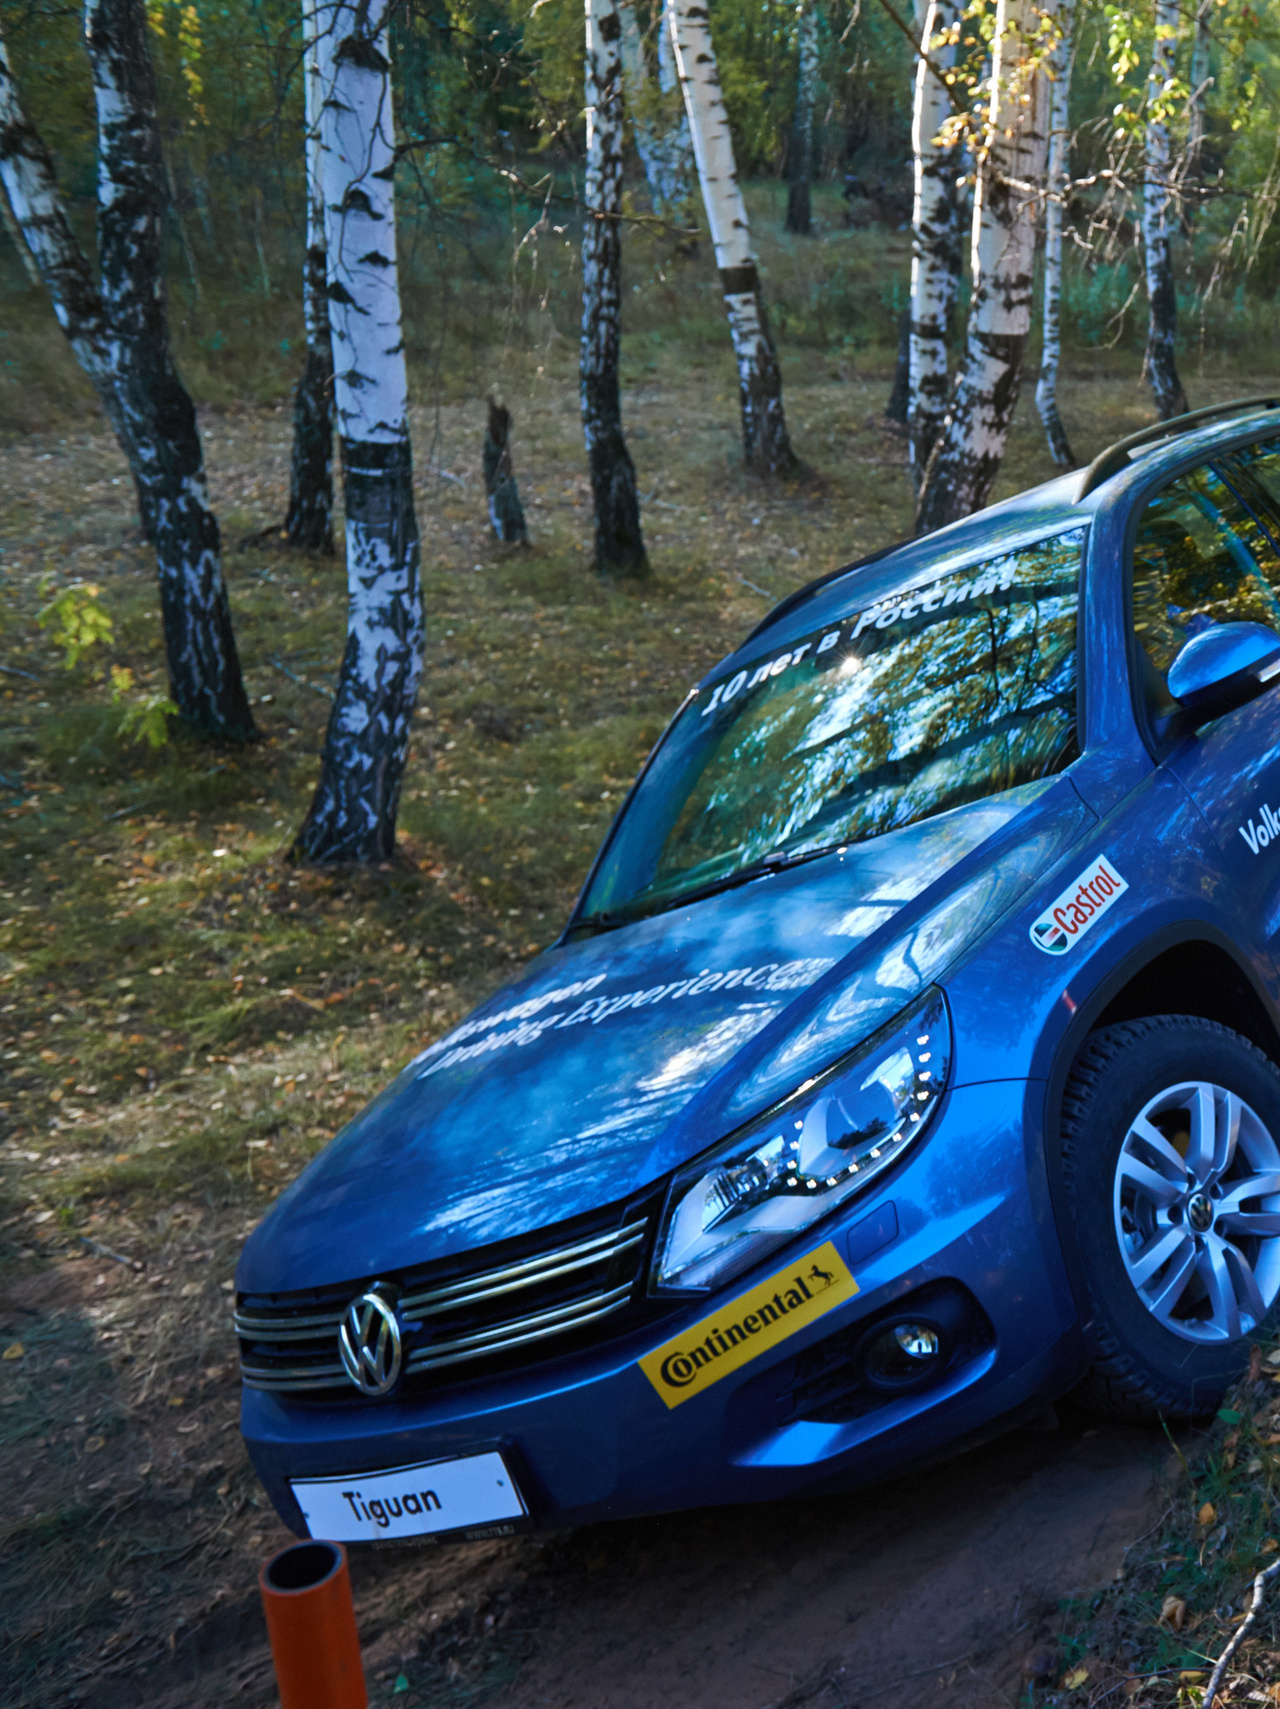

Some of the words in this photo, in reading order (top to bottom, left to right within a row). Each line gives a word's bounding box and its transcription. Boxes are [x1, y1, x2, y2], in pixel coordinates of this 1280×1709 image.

[701, 669, 748, 716] 10
[747, 642, 812, 689] лет
[816, 630, 841, 654] в
[850, 555, 1019, 640] России!
[1053, 864, 1121, 934] Castrol
[554, 959, 802, 1024] Experience
[660, 1276, 814, 1388] Continental
[342, 1489, 442, 1528] Tiguan
